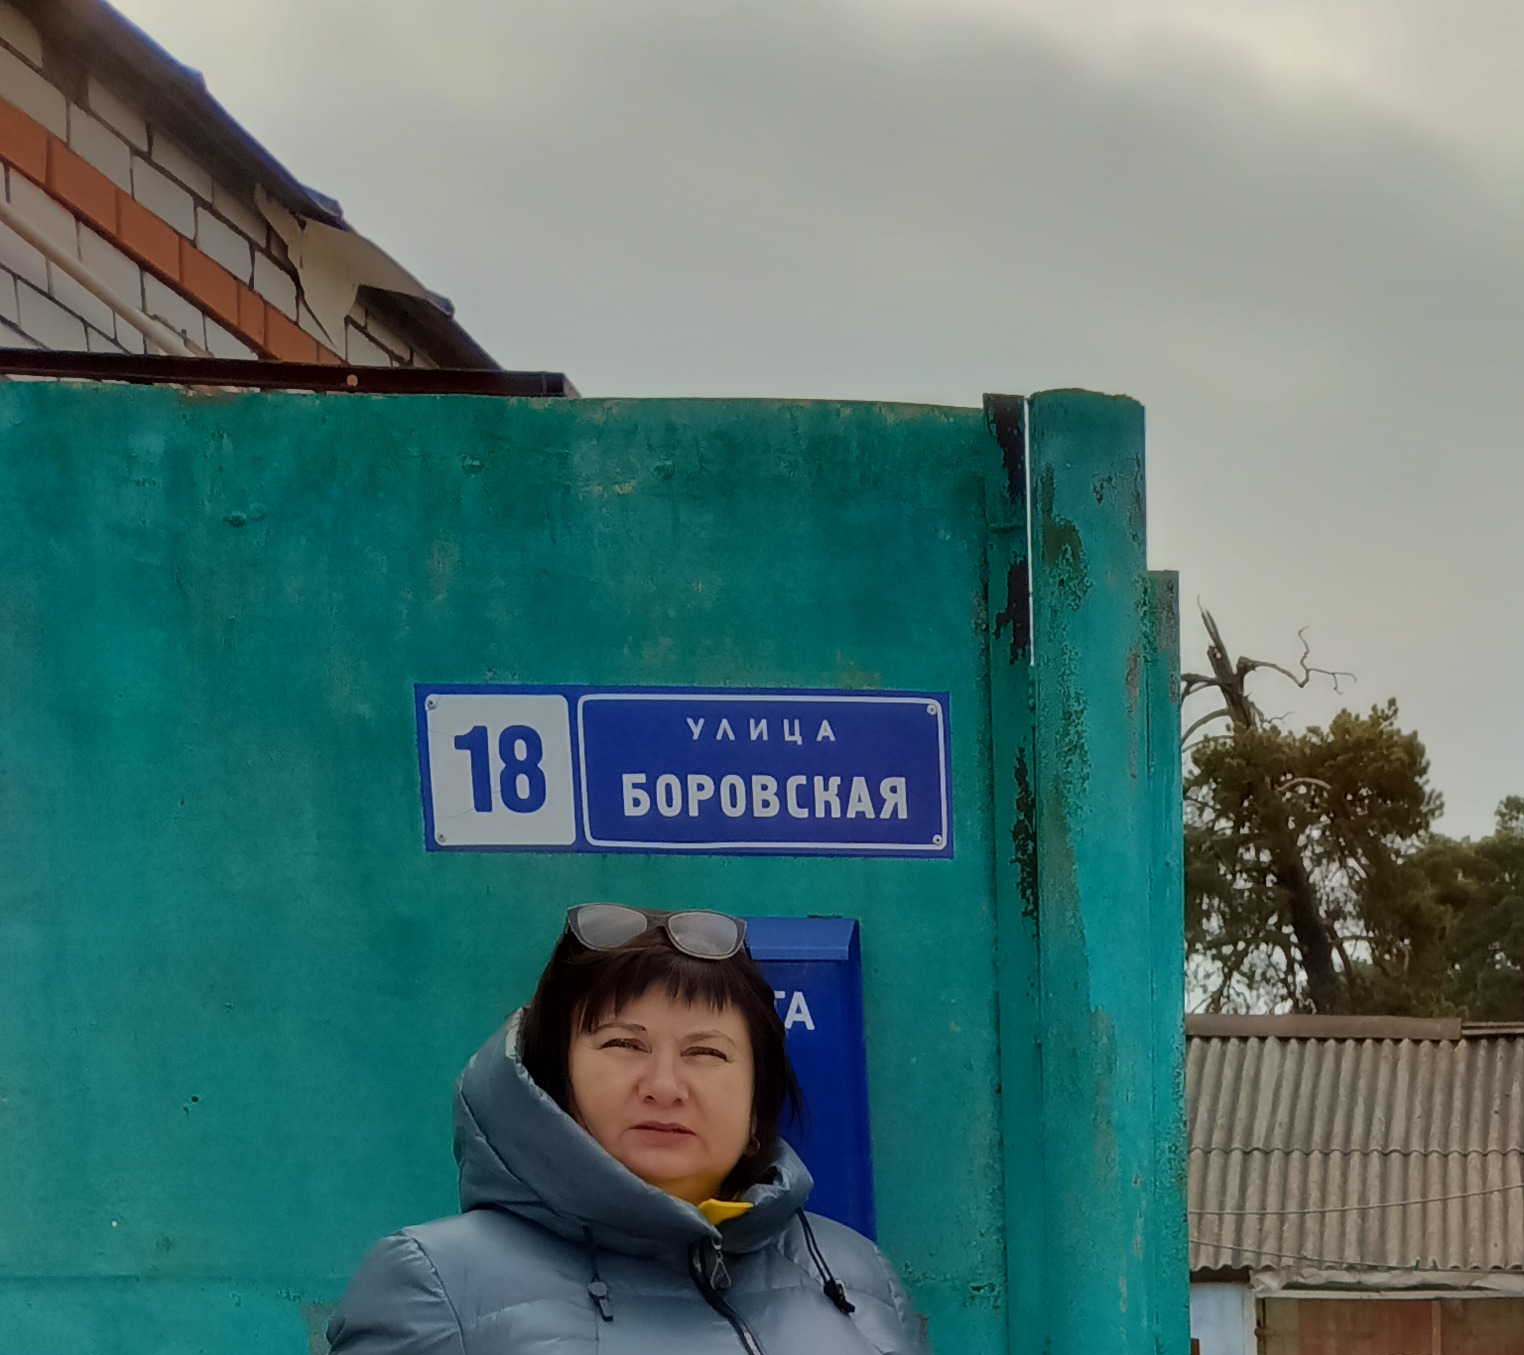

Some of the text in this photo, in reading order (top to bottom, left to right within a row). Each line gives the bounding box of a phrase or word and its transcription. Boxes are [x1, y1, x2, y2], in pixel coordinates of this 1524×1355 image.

[686, 717, 836, 745] УЛИЦА
[453, 724, 547, 814] 18
[622, 773, 908, 820] БОРОВСКАЯ
